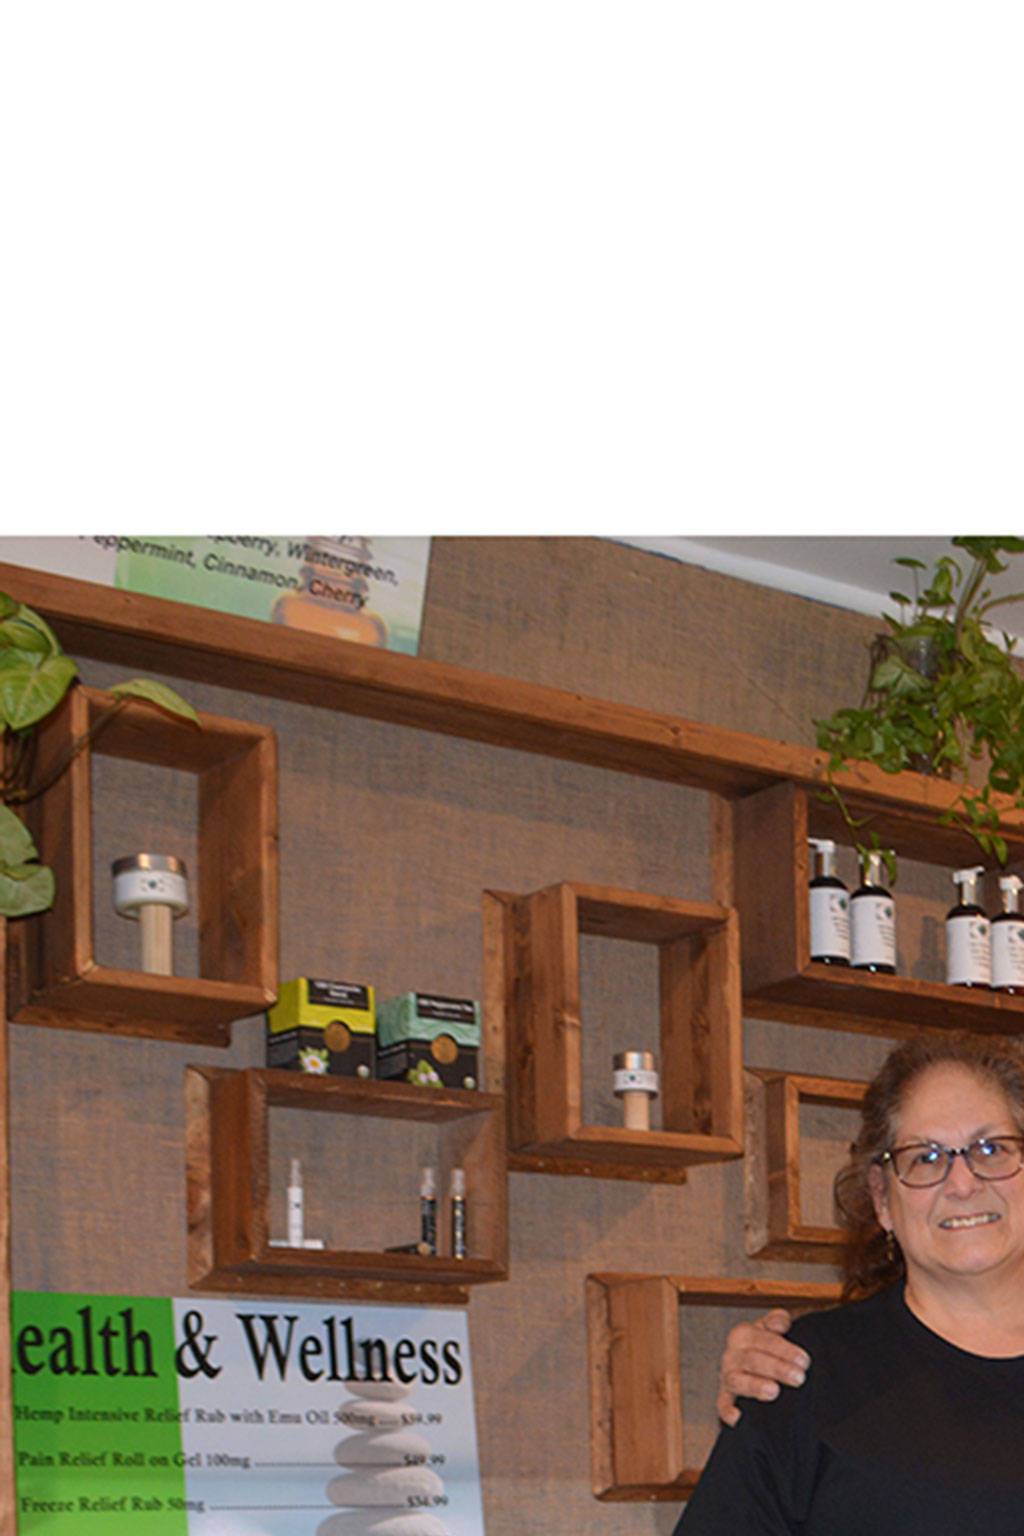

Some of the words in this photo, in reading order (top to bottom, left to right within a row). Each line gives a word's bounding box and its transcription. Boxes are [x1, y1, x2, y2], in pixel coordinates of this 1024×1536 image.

[79, 536, 196, 568] eppermint,
[309, 579, 368, 608] Cherry
[13, 1306, 158, 1378] ealth
[175, 1310, 222, 1379] &
[235, 1314, 462, 1385] Wellness
[15, 1406, 64, 1424] Hemp
[69, 1407, 139, 1423] Intensive
[143, 1408, 190, 1423] Relief
[195, 1409, 225, 1423] Rub
[230, 1409, 264, 1424] with
[305, 1409, 329, 1425] Oil
[18, 1451, 54, 1467] Pain
[59, 1451, 107, 1467] Relief
[112, 1451, 146, 1467] Roll
[150, 1456, 169, 1467] on
[174, 1452, 201, 1467] Gel
[206, 1453, 250, 1470] 100mg
[21, 1497, 74, 1513] Freeze
[78, 1496, 127, 1512] Relief
[132, 1496, 162, 1512] Rub
